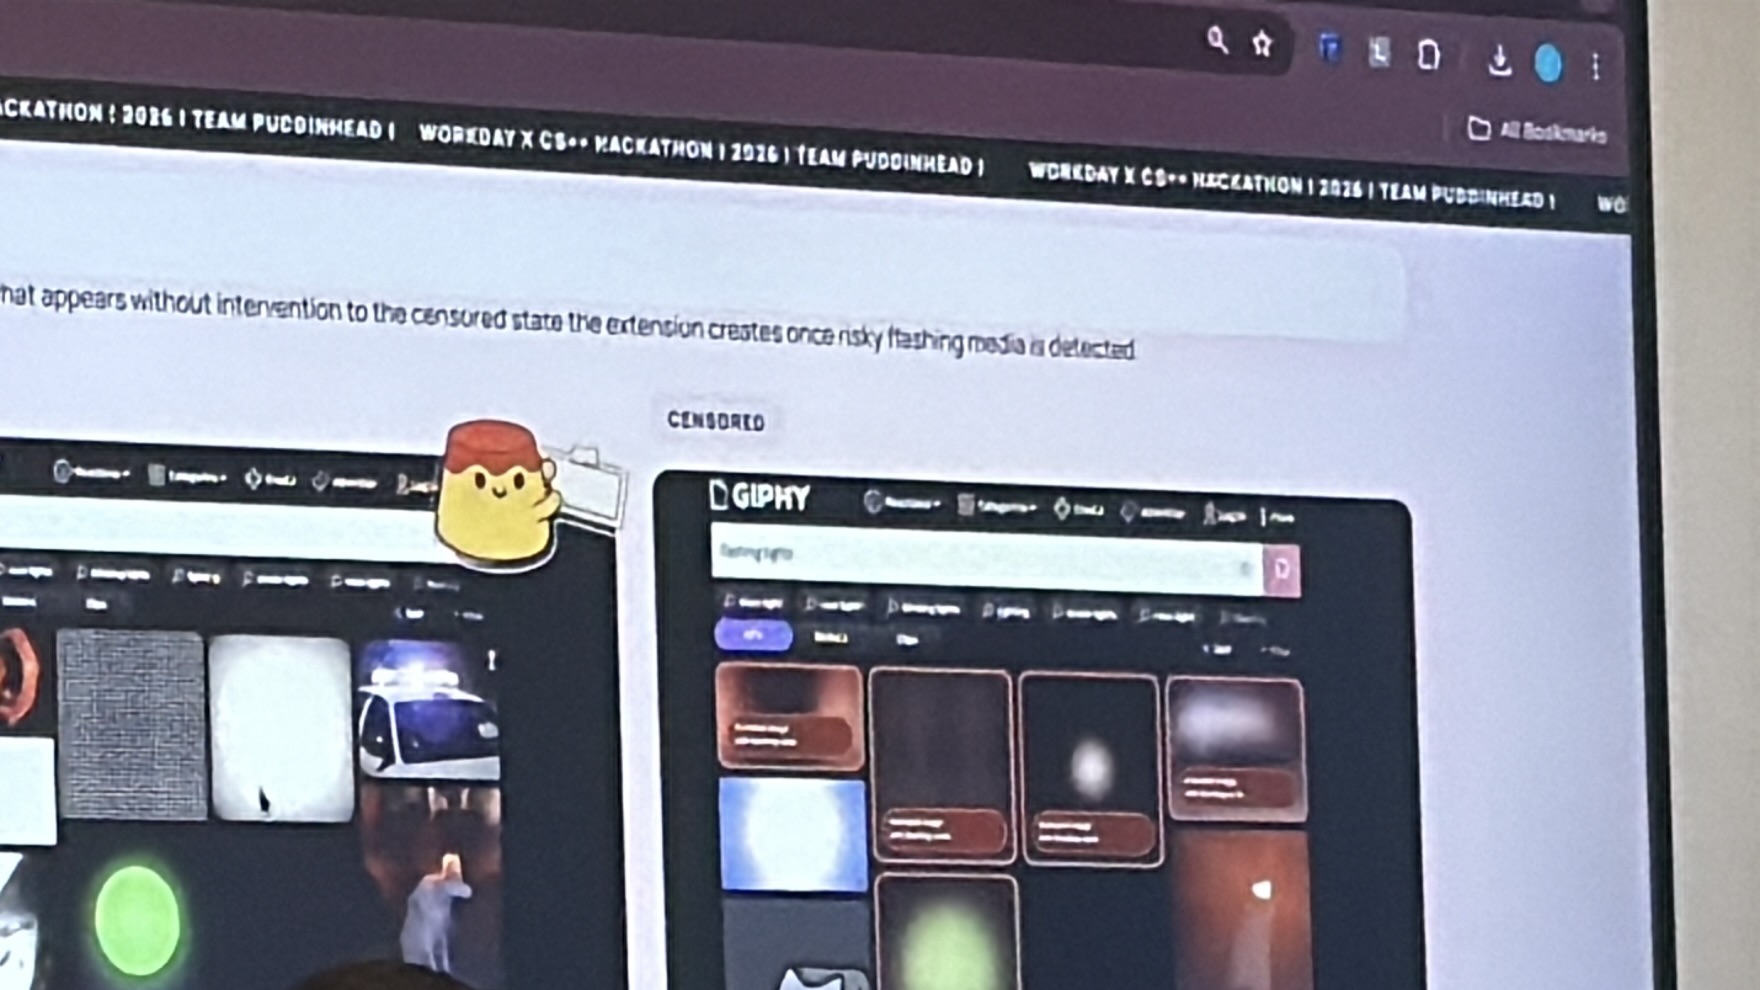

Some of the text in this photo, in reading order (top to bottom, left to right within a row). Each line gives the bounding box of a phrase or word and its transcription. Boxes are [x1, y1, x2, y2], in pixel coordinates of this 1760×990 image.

[191, 108, 248, 131] TEAM
[418, 123, 516, 148] WORKDAY
[520, 130, 535, 151] X
[594, 135, 714, 160] HACKATHON
[730, 142, 779, 164] 2026
[796, 144, 846, 168] TEAM
[1028, 161, 1120, 185] WORKDAY
[1124, 166, 1136, 186] X
[1192, 171, 1304, 196] HACKATHON
[1378, 181, 1427, 202] TEAM
[41, 286, 128, 314] appears
[131, 287, 212, 316] without
[216, 291, 342, 321] intervention
[347, 299, 369, 323] to
[372, 301, 407, 325] the
[512, 311, 562, 333] state
[568, 312, 602, 335] the
[606, 313, 704, 340] extension
[708, 320, 783, 344] creates
[787, 325, 836, 346] once
[839, 325, 883, 356] risky
[889, 324, 966, 359] flashing
[667, 410, 766, 432] CENSORED
[732, 481, 811, 511] GIPHY
